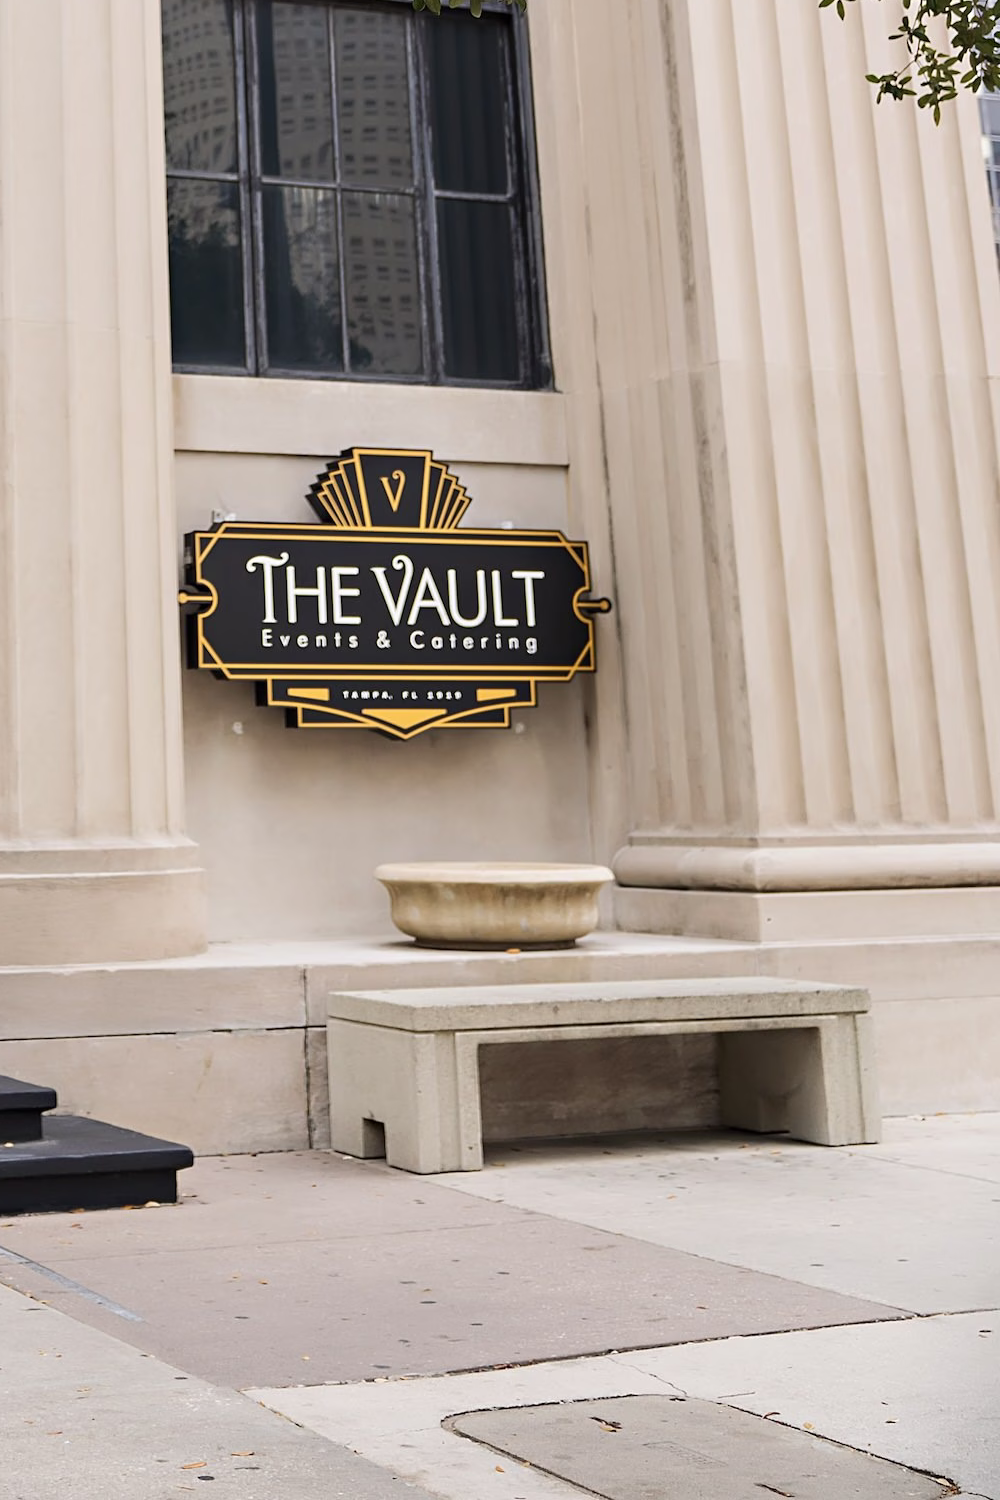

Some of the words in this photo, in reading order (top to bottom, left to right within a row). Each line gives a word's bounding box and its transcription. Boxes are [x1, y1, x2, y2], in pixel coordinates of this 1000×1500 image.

[379, 469, 406, 512] V
[370, 554, 545, 627] VAULT
[261, 629, 359, 649] Events
[376, 630, 391, 649] &
[409, 630, 539, 654] Catering
[402, 690, 418, 700] FL
